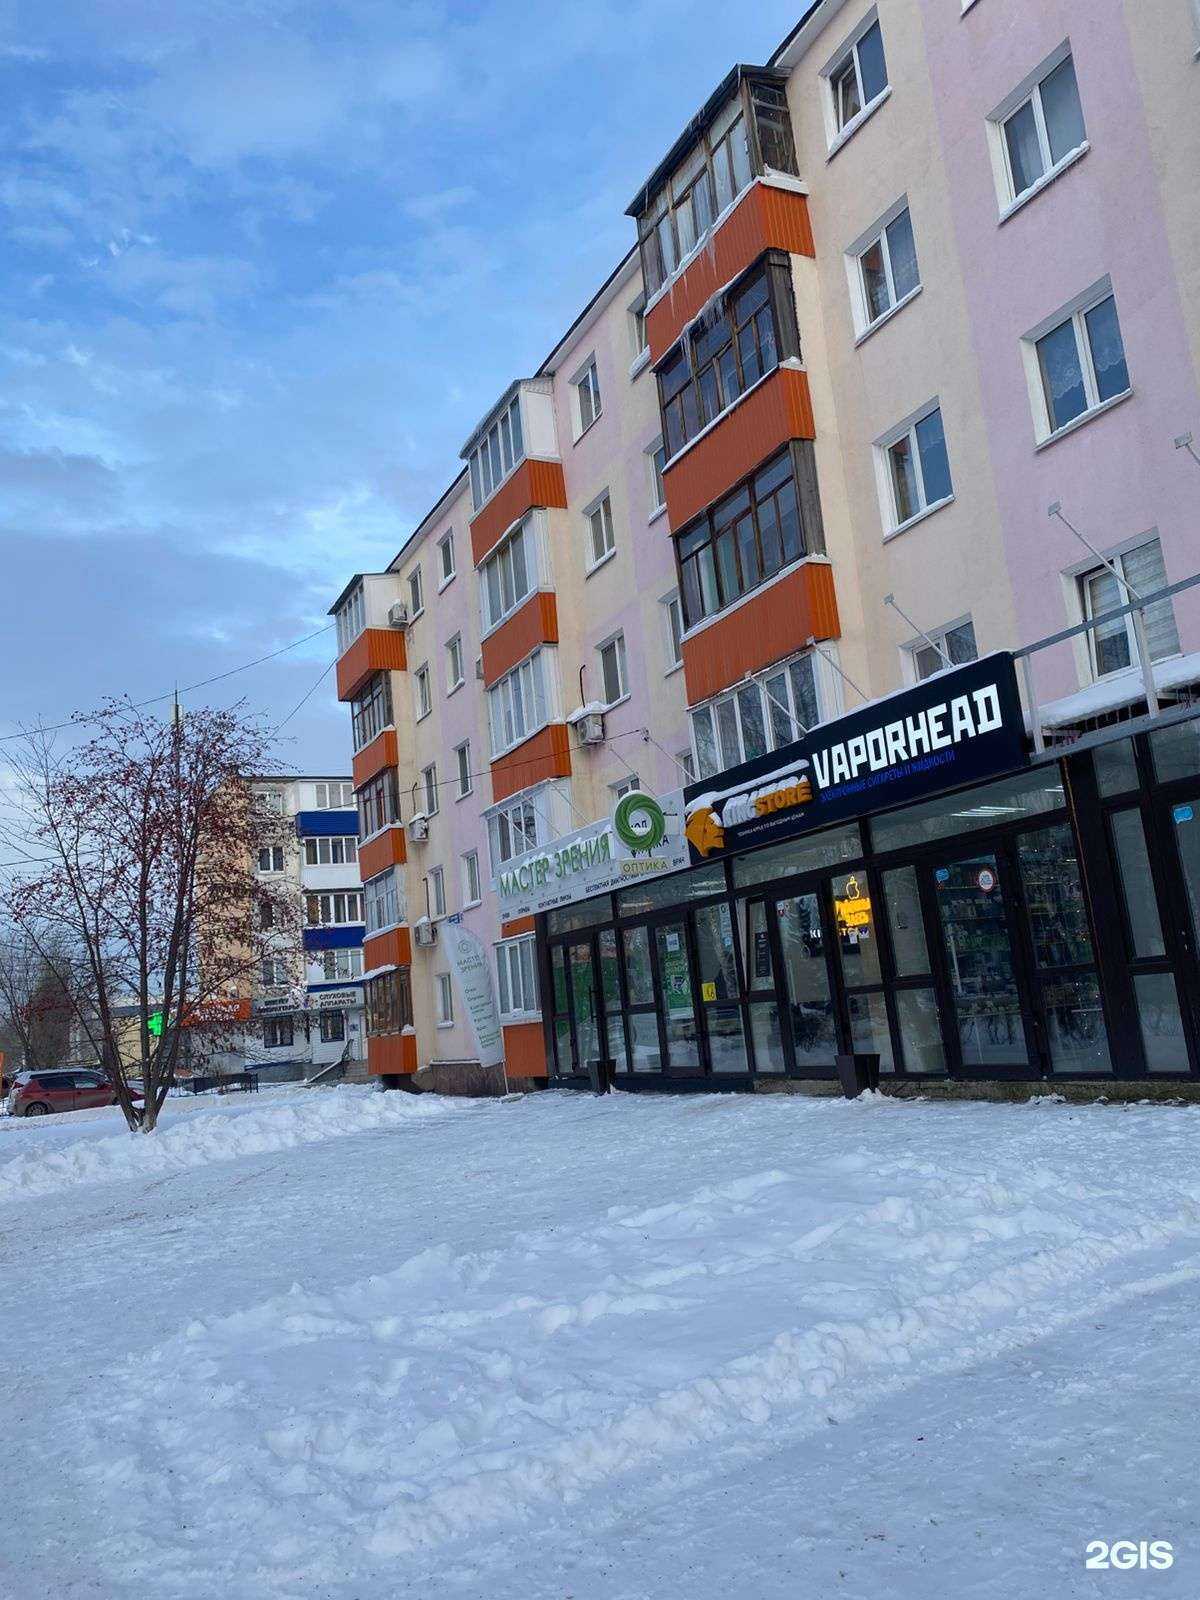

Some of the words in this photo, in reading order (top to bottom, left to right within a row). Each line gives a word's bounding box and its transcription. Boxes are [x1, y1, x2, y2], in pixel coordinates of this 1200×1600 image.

[812, 684, 1003, 790] VAPORHEAD
[500, 857, 550, 898] МАСТЕР
[555, 832, 612, 878] ЗРЕНИЯ
[622, 860, 668, 873] ОПТИКА
[320, 999, 357, 1009] АППАРАТЫ
